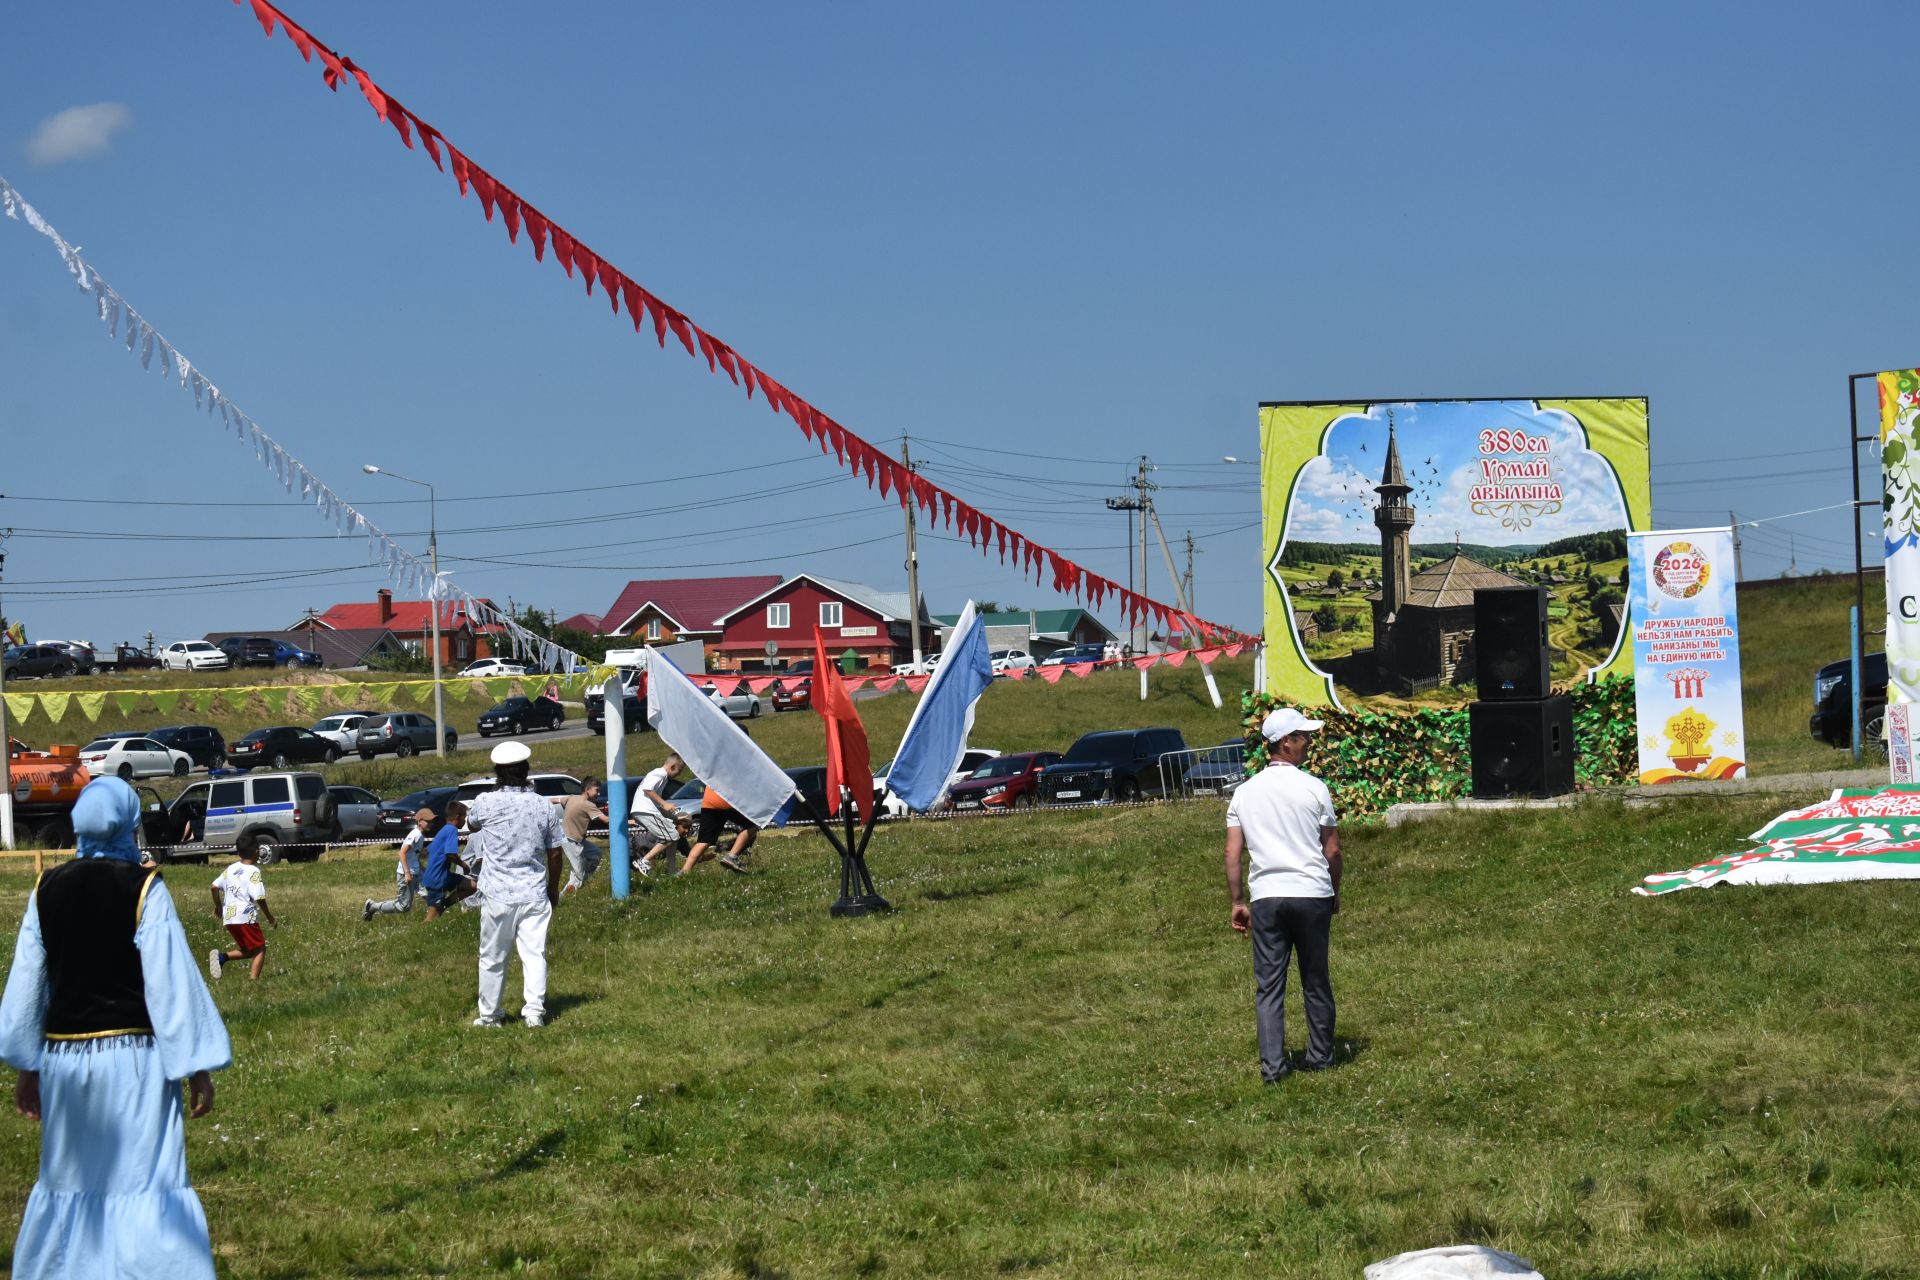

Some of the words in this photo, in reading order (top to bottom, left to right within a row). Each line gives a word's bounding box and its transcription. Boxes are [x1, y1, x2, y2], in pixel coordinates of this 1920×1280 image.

[1662, 558, 1701, 570] 2026
[1644, 620, 1681, 630] ДРУЖБУ
[1684, 617, 1724, 626] НАРОДОВ
[1637, 631, 1671, 640] НЕЛЬЗЯ
[1673, 630, 1692, 638] НАМ
[1695, 628, 1733, 637] РАЗБИТЬ
[1652, 641, 1700, 651] НАНИЗАНЫ
[1702, 640, 1718, 648] МЫ
[1647, 654, 1658, 662] НА
[1661, 652, 1698, 662] ЕДИНУЮ
[1700, 651, 1725, 660] НИТЬ!
